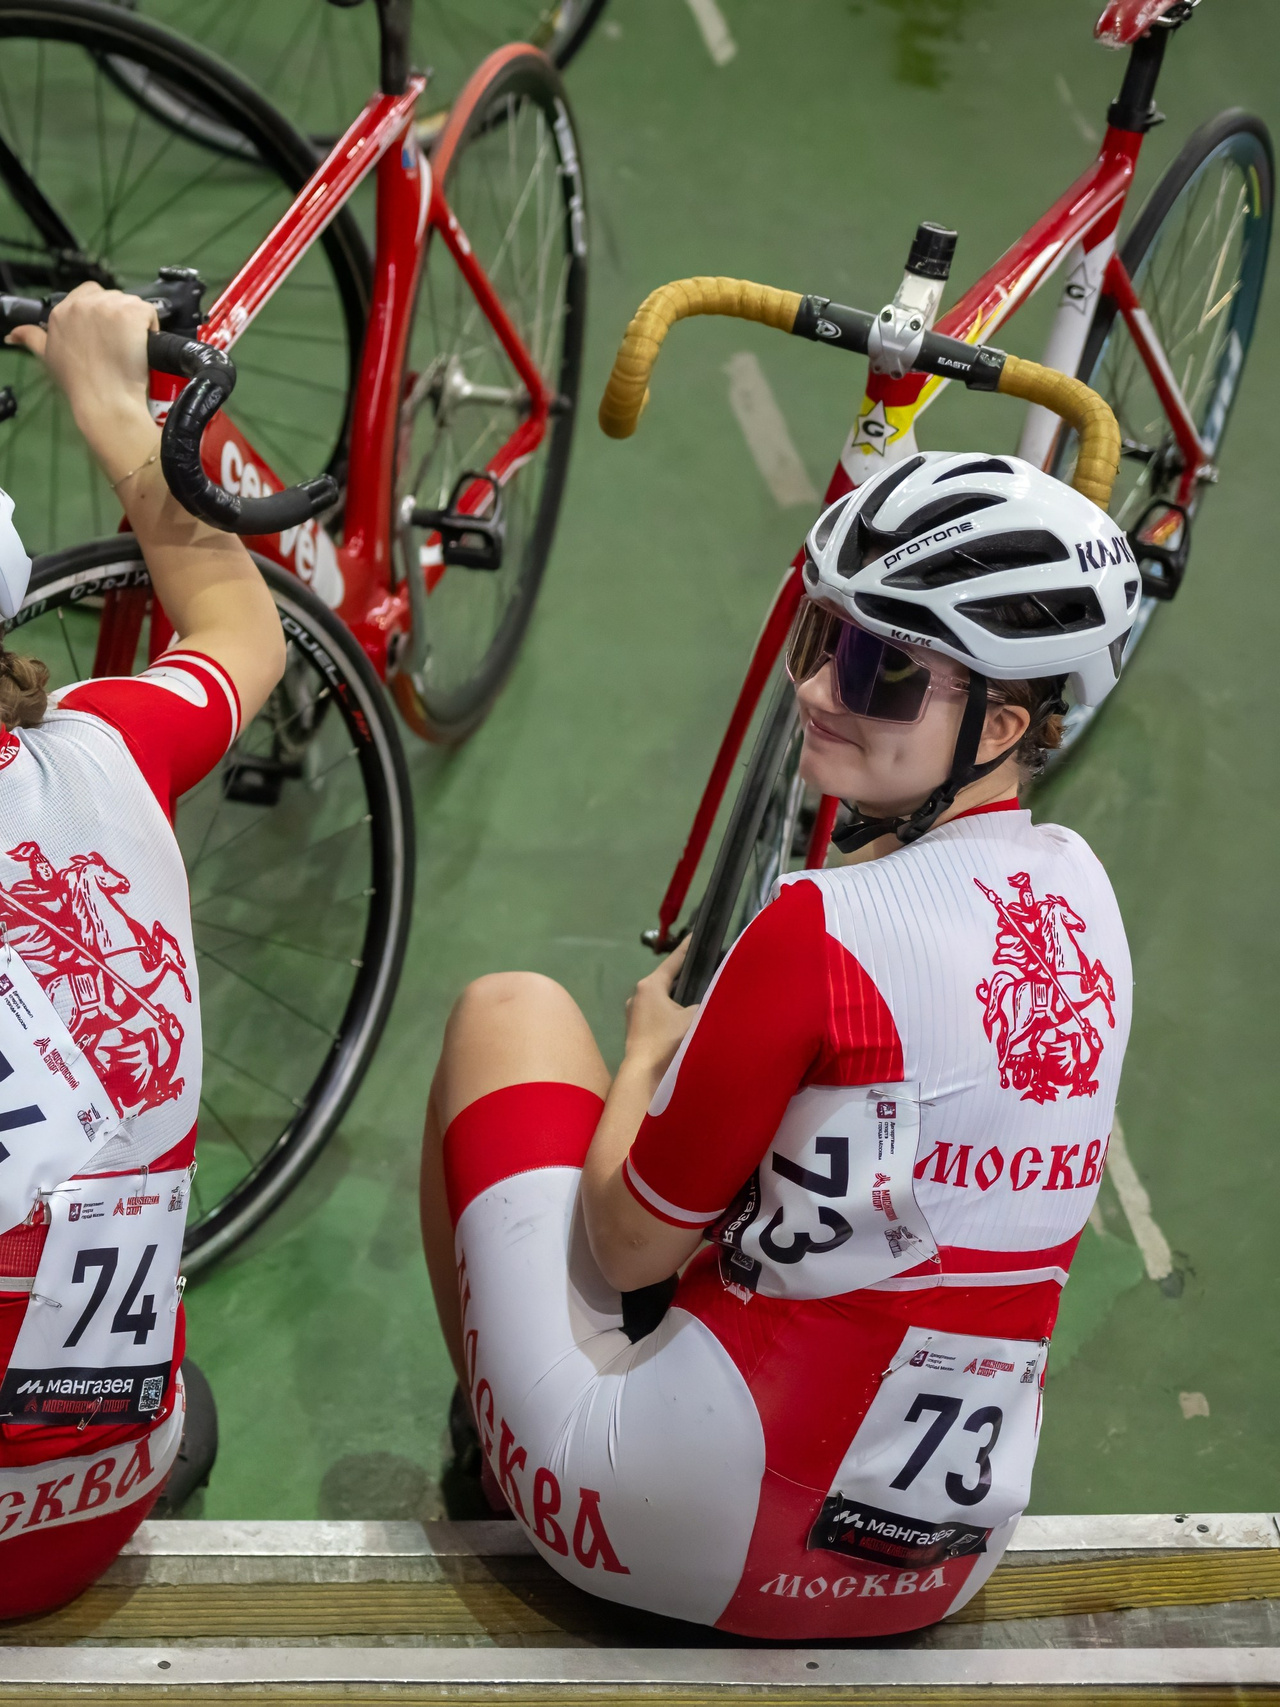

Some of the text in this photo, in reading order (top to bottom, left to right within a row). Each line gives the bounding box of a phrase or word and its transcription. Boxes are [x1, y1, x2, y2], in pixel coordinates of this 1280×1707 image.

[890, 629, 931, 648] KASK
[758, 1136, 853, 1264] 73
[62, 1244, 158, 1349] 74
[46, 1378, 134, 1395] мангазея
[888, 1393, 1004, 1506] 73
[866, 1519, 956, 1545] мангазея
[759, 1566, 948, 1599] МОСКВА
